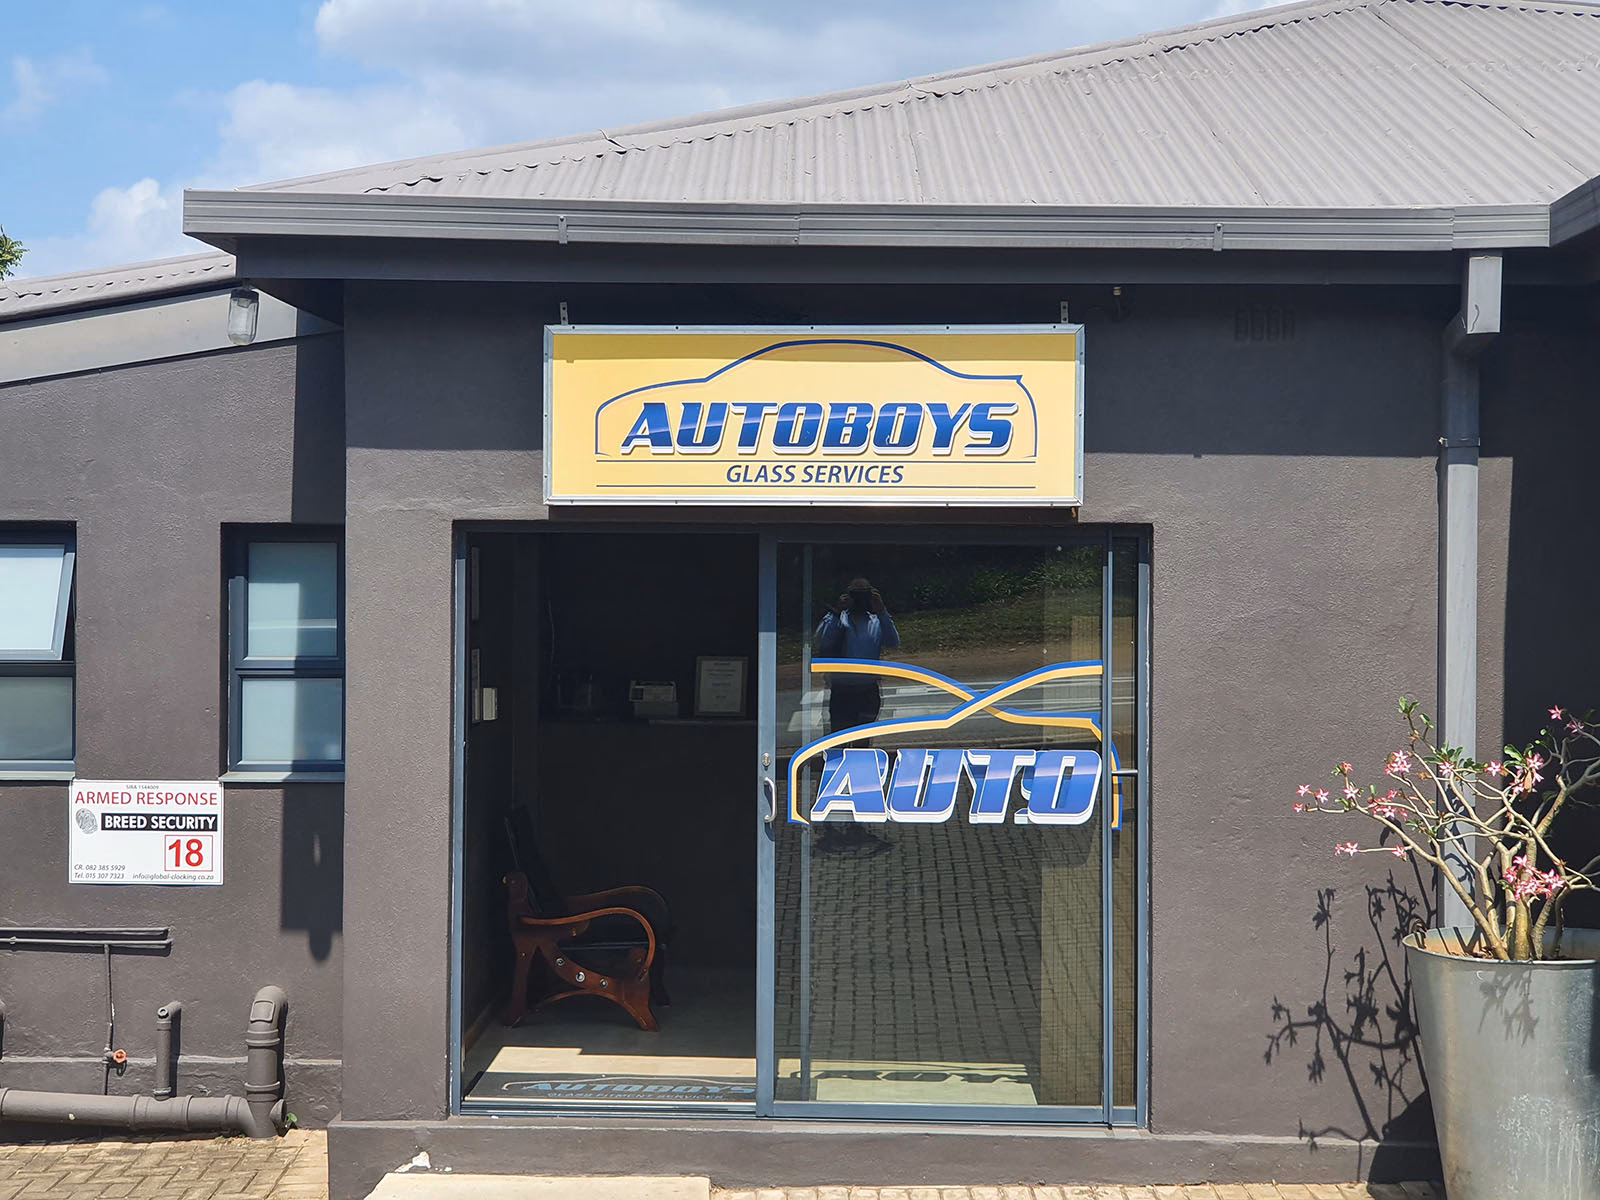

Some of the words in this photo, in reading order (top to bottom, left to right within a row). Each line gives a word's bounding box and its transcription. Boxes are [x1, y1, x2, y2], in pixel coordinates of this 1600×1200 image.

[620, 402, 1018, 456] AUTOBOYS
[726, 464, 795, 483] GLASS
[801, 465, 904, 484] SERVICES
[75, 791, 132, 804] ARMED
[137, 792, 218, 805] RESPONSE
[810, 748, 1102, 825] AUTO
[105, 815, 147, 829] BREED
[151, 816, 216, 830] SECURITY
[168, 838, 204, 867] 18
